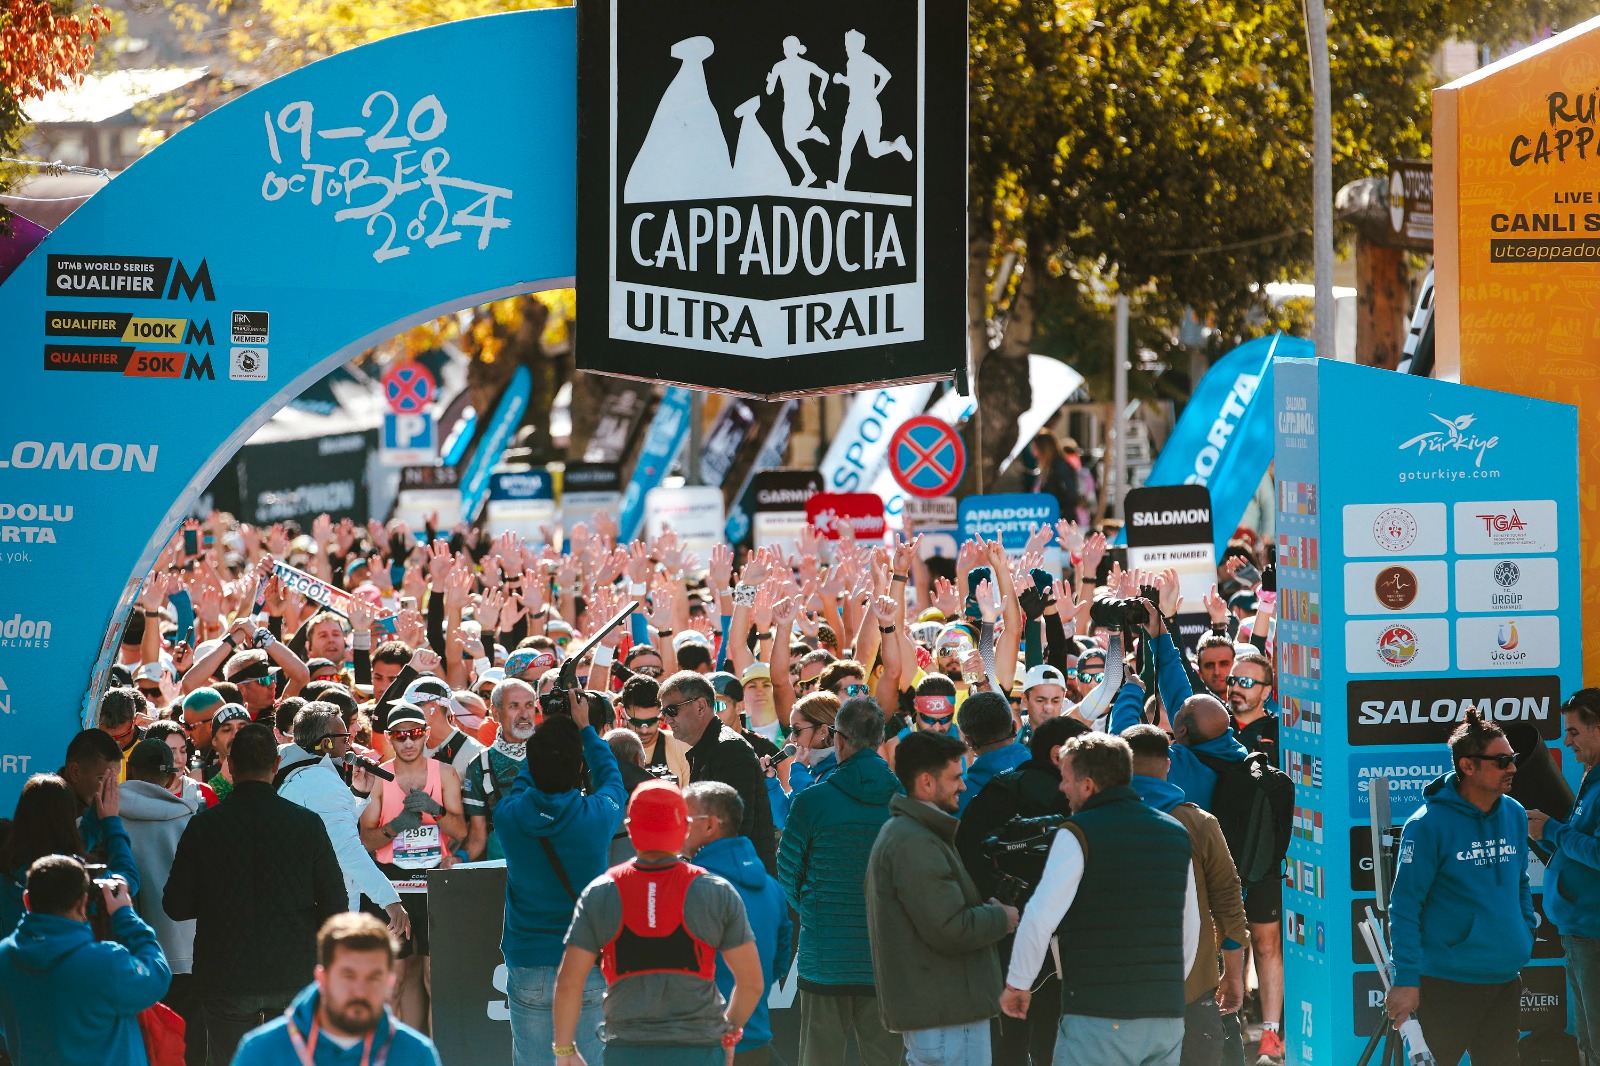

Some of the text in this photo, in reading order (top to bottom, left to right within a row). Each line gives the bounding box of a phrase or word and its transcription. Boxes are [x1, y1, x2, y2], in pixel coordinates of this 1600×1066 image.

[1547, 90, 1600, 127] RU
[1509, 127, 1600, 167] CAPP
[1554, 192, 1592, 204] LIVE
[366, 194, 512, 263] 2024
[1490, 213, 1575, 233] CANLI
[630, 203, 907, 276] CAPPADOCIA
[57, 261, 155, 273] UTMB WORLD SERIES
[56, 274, 155, 292] QUALIFIER
[51, 318, 117, 330] QUALIFIER
[132, 322, 177, 338] 100K
[626, 290, 904, 347] ULTRA TRAIL
[50, 352, 118, 365] QUALIFIER
[137, 356, 175, 373] 50K
[395, 413, 426, 448] P
[1399, 469, 1501, 483] goturkiye.com
[965, 507, 1050, 521] ANADOLU
[1132, 508, 1210, 527] SALOMON
[1476, 508, 1527, 537] TGA
[0, 525, 57, 544] RTA
[7, 551, 32, 564] yok.
[1144, 550, 1208, 561] GATE NUMBER
[1492, 593, 1523, 605] ÜRGÜP
[1, 640, 49, 649] RLINES
[1491, 651, 1526, 660] ÜRGÜP
[1358, 696, 1550, 725] SALOMON
[0, 754, 31, 774] RT
[1357, 765, 1443, 778] ANADOLU
[405, 827, 434, 839] 2987
[648, 881, 657, 928] SALOMON
[1301, 1000, 1313, 1038] 73
